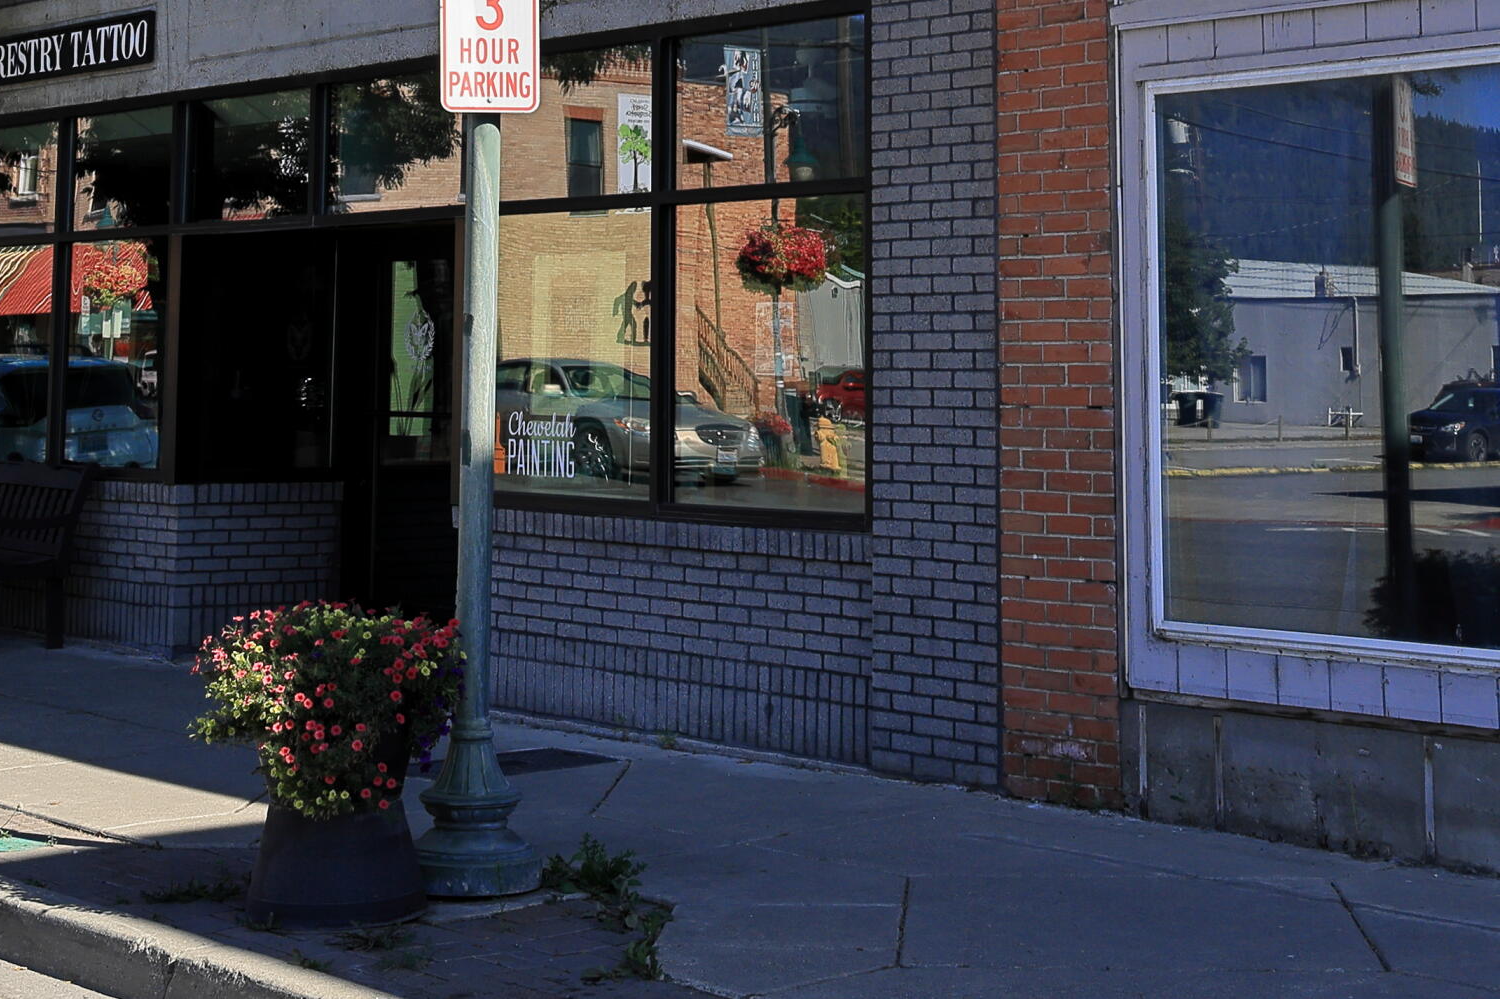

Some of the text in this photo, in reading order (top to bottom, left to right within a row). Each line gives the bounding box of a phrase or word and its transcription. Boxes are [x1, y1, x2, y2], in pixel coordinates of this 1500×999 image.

[70, 19, 148, 68] TATTOO
[460, 37, 519, 64] HOUR
[449, 71, 531, 98] PARKING
[508, 411, 576, 438] Chewelah
[507, 438, 575, 478] PAINTING
